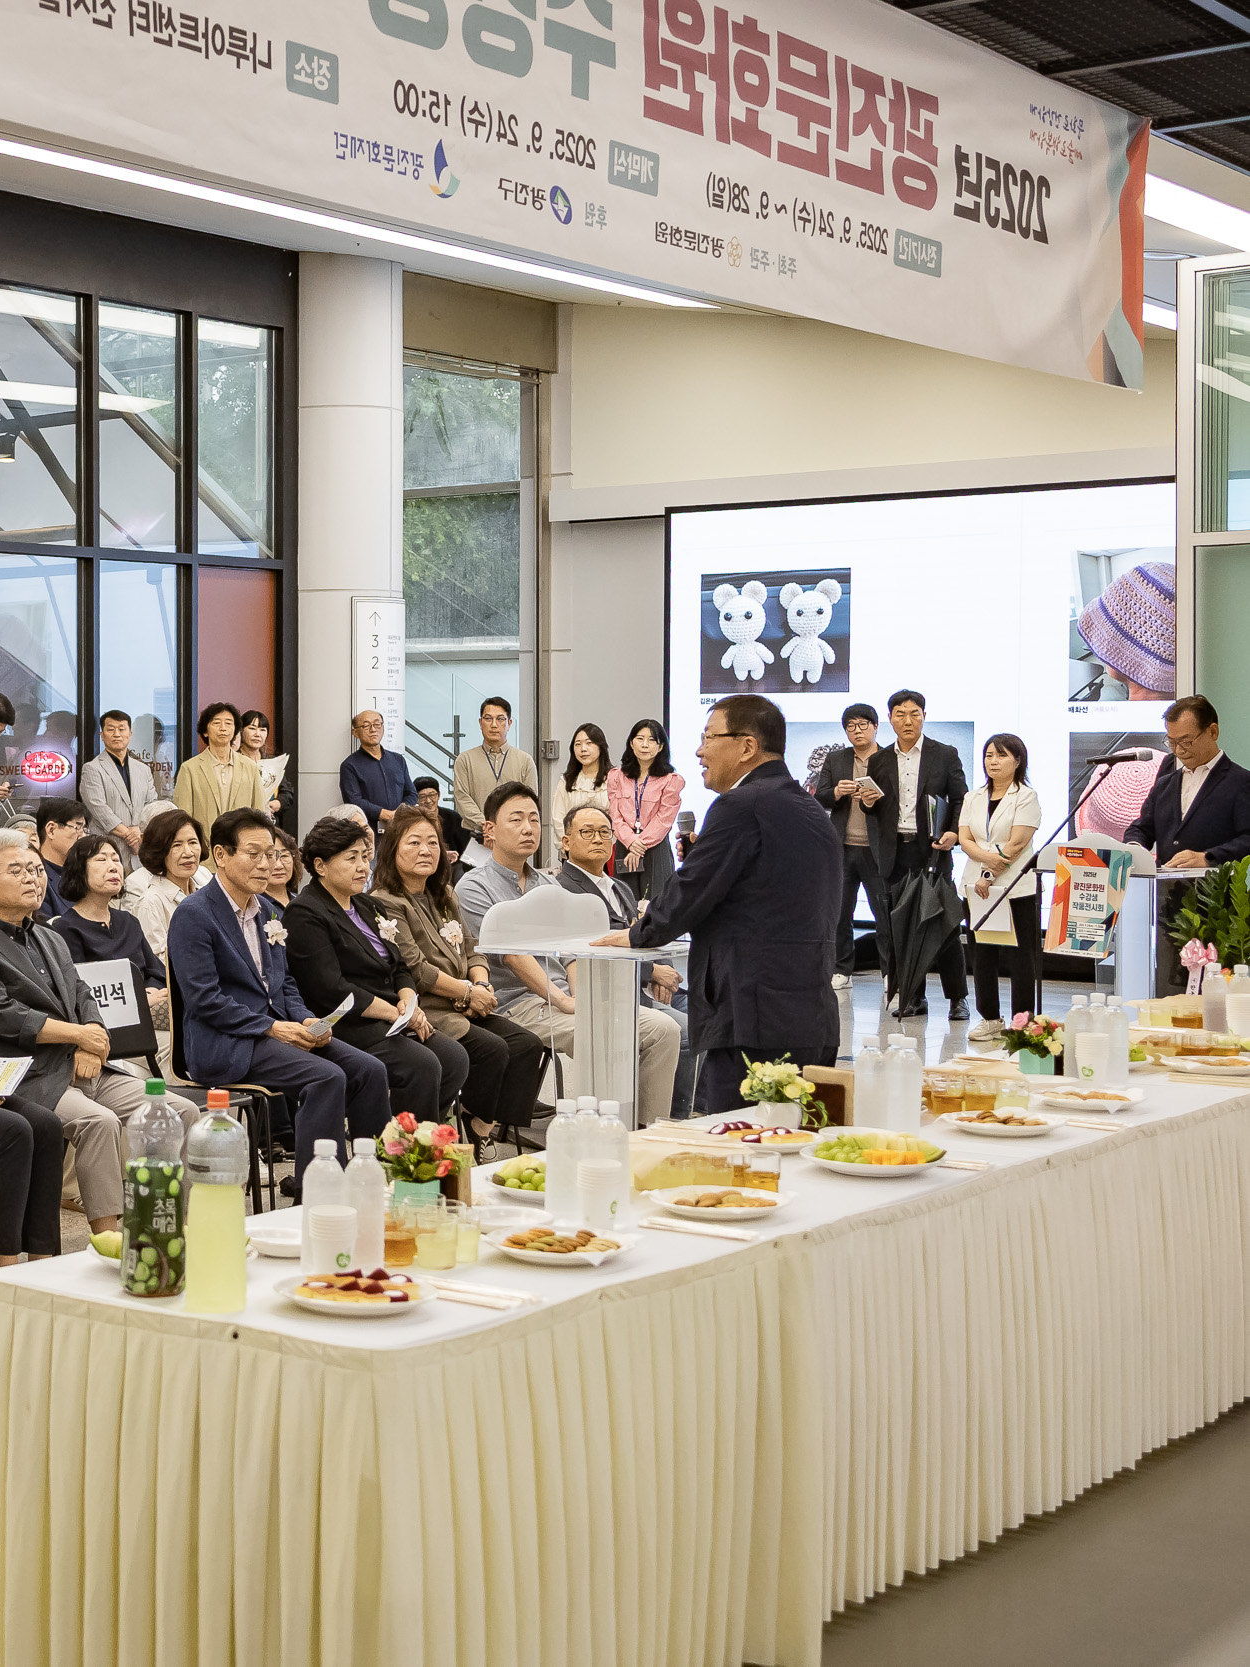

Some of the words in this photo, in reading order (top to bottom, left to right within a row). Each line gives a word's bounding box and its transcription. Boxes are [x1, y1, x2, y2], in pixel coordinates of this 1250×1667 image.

[371, 634, 379, 648] 3
[371, 656, 379, 669] 2
[372, 696, 377, 709] 1
[0, 764, 32, 776] SWEET
[146, 762, 173, 773] RDEN
[1073, 882, 1105, 892] 광진문화원
[1079, 893, 1099, 901] 수강생
[1072, 902, 1104, 912] 작품전시회
[92, 982, 127, 1008] 빈석
[152, 1198, 177, 1215] 초록
[152, 1215, 177, 1234] 매실
